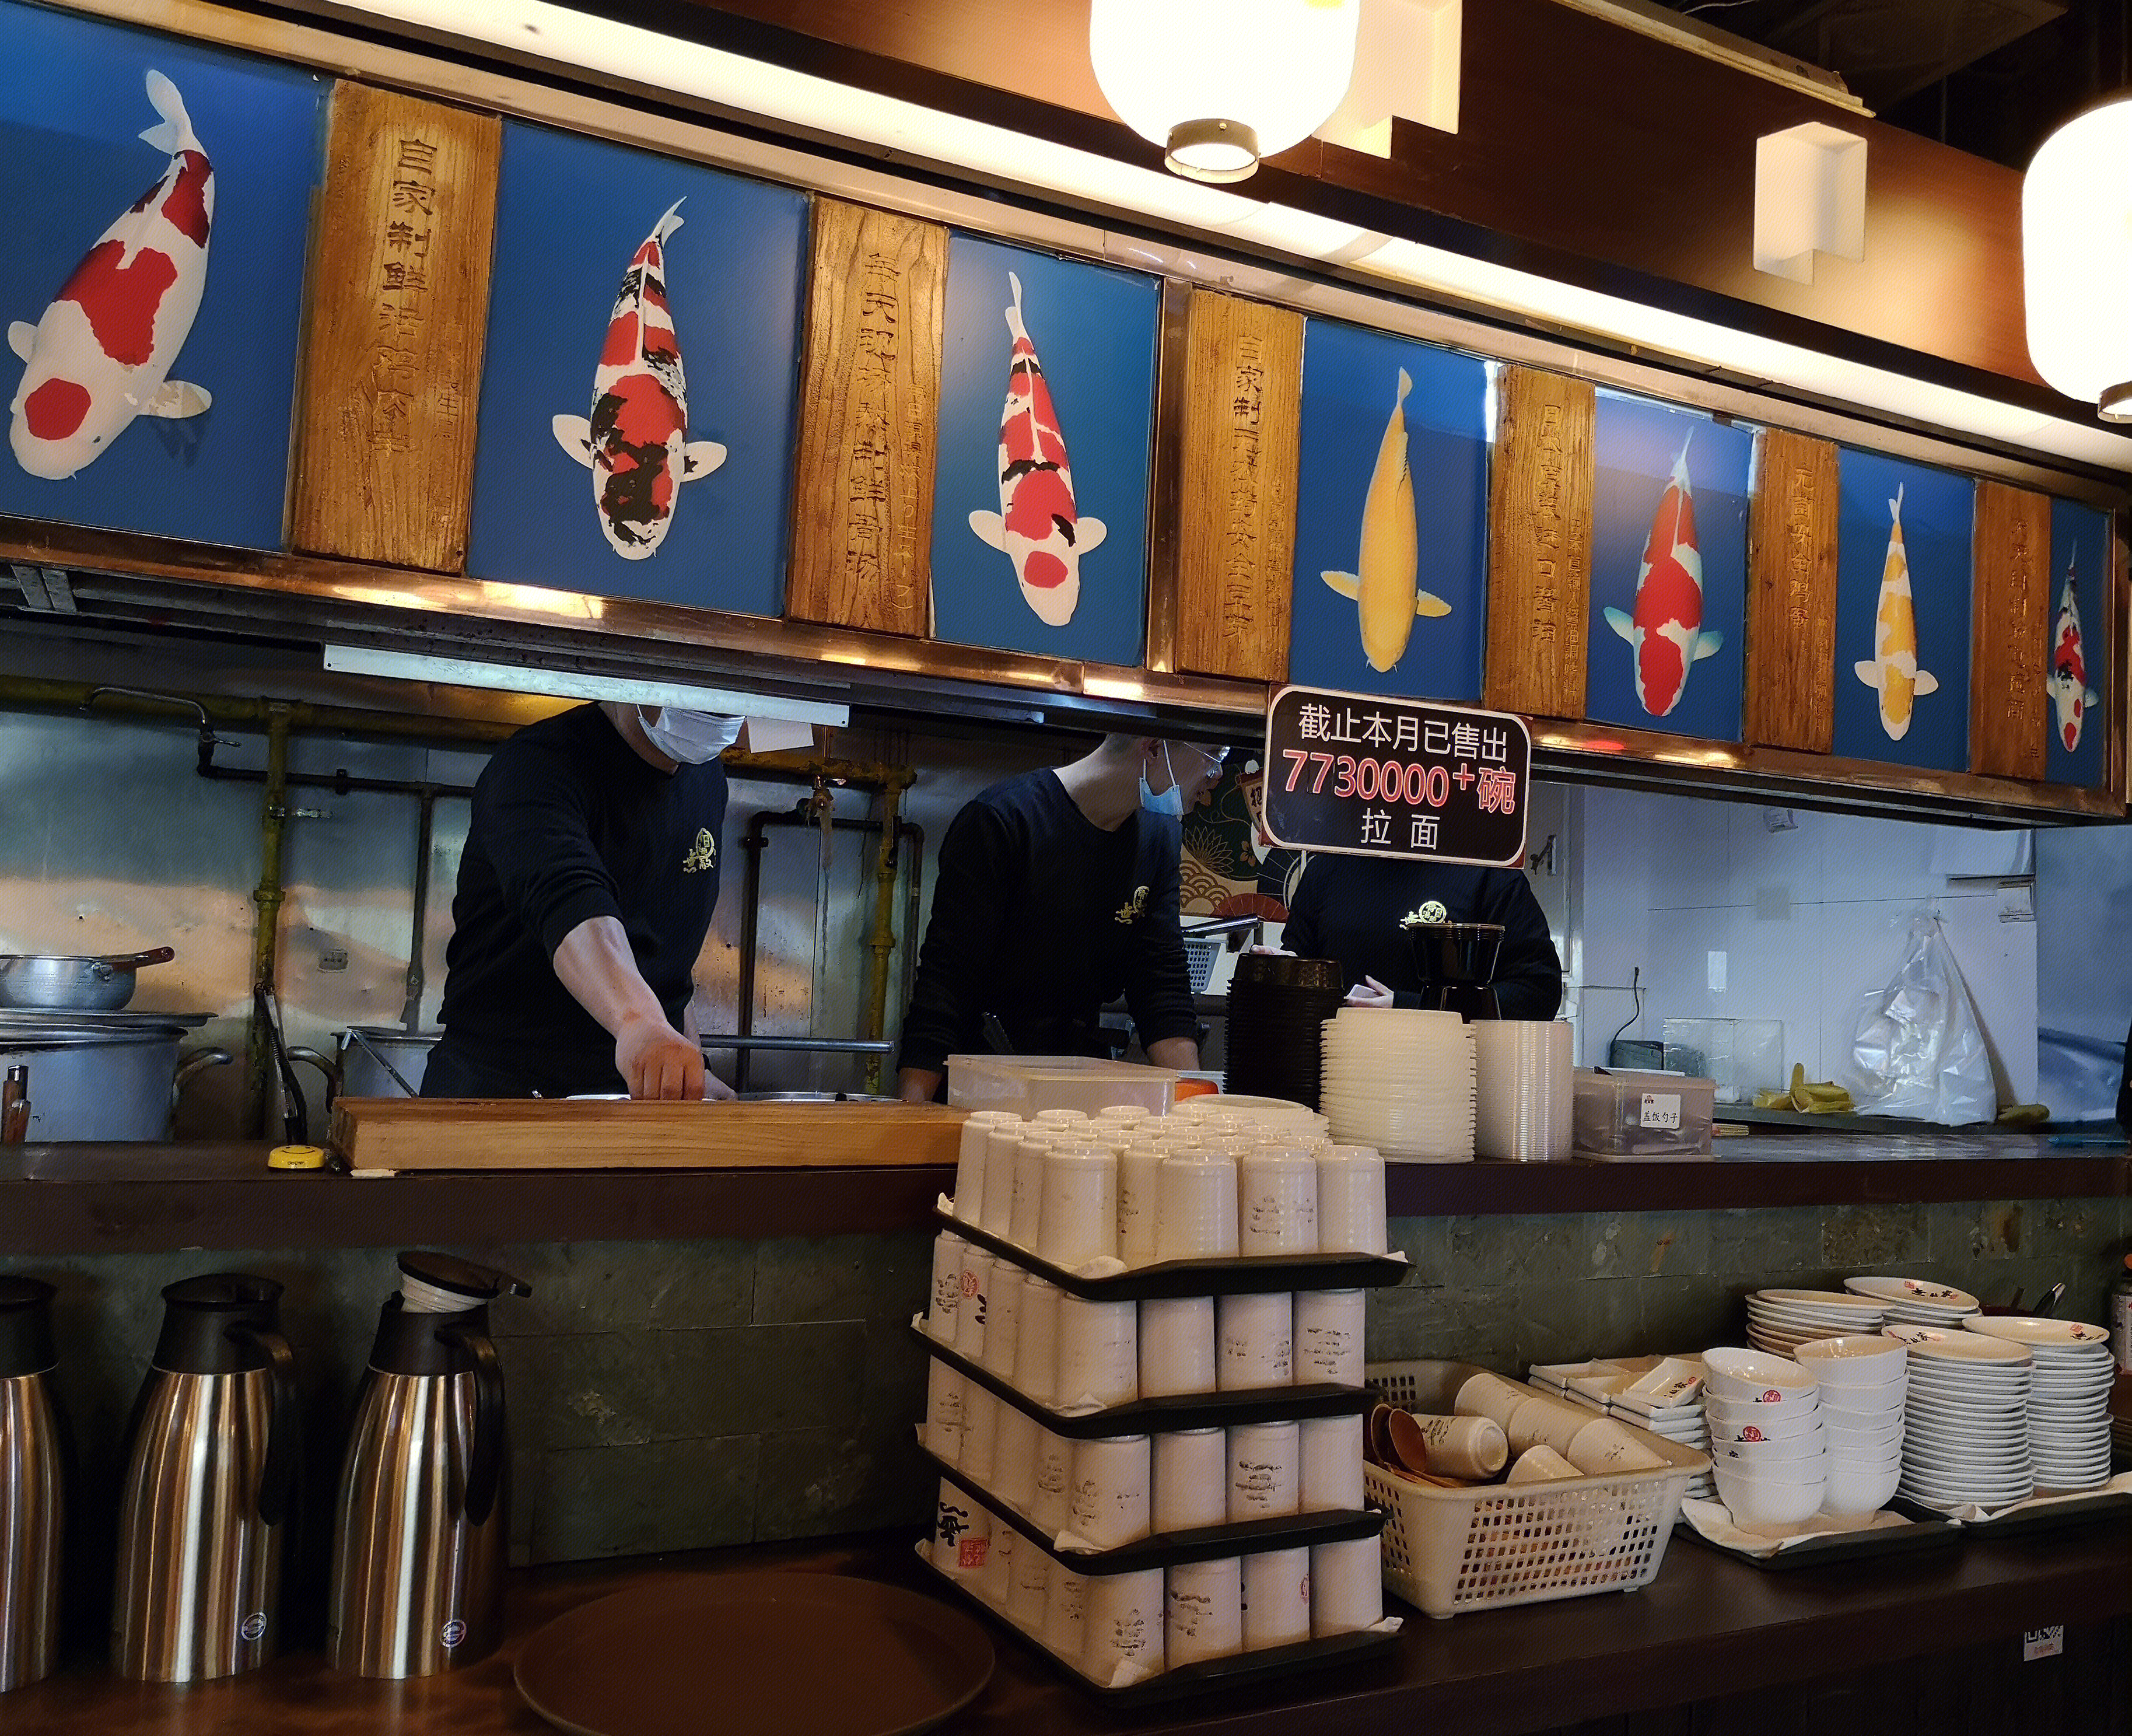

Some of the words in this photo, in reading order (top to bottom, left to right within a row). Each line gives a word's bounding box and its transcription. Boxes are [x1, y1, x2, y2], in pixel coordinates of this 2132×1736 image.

[1298, 703, 1506, 762] 截止本月已售出
[1361, 808, 1440, 850] 拉面
[1642, 1111, 1678, 1124] 盖饭勺子
